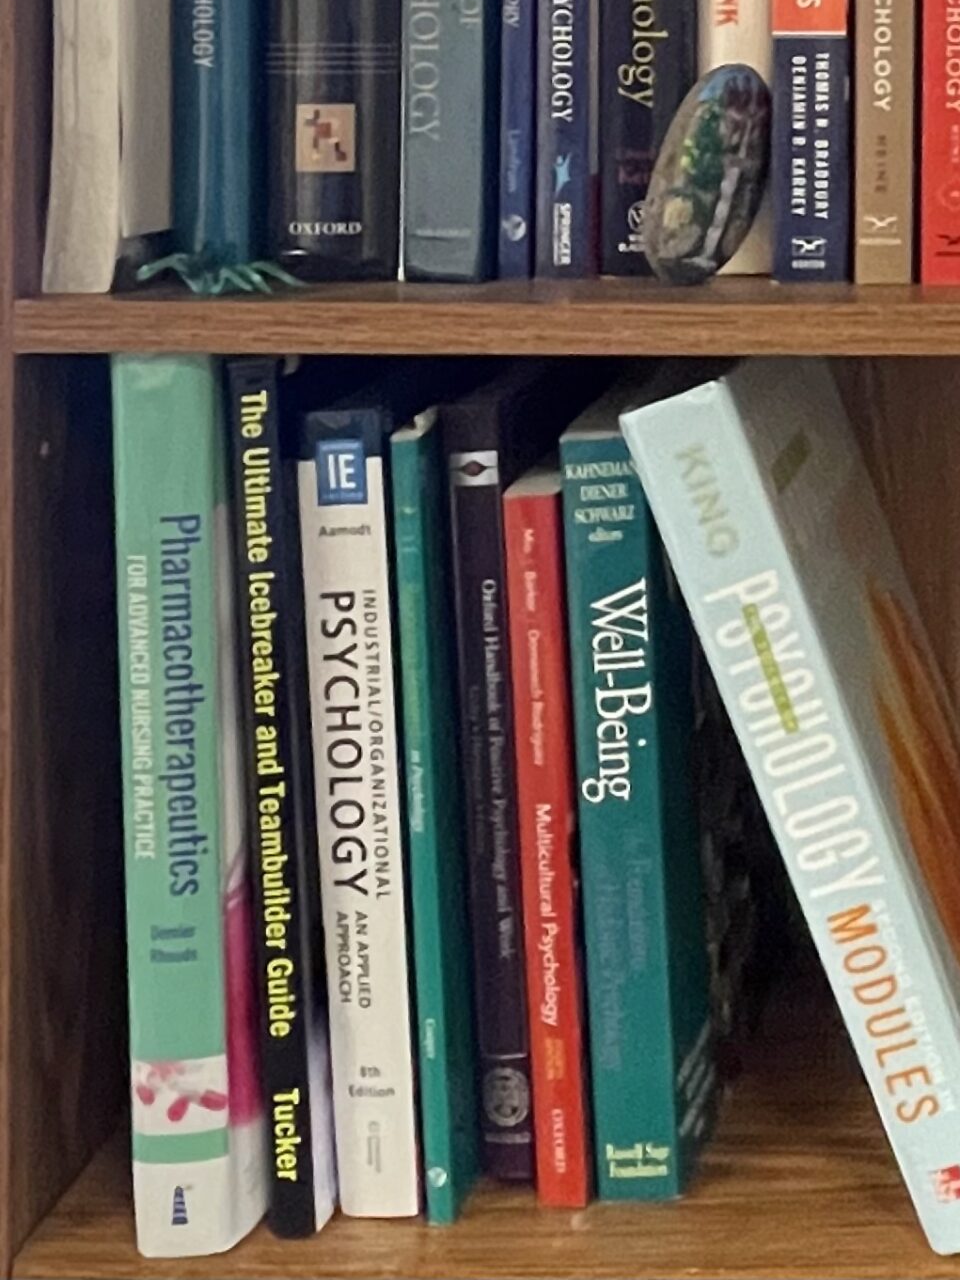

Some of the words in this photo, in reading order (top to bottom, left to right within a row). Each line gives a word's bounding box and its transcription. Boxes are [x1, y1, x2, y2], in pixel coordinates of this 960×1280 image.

[289, 220, 362, 235] OXFORD
[558, 202, 572, 266] SPRINGER
[241, 390, 268, 439] The
[241, 447, 273, 564] Ultimate
[327, 453, 356, 489] IE
[574, 504, 635, 523] SCHWARZ
[579, 483, 629, 500] DIENER
[675, 442, 739, 560] KING
[127, 554, 147, 587] FOR
[318, 524, 371, 538] Aamodt
[128, 592, 152, 684] ADVANCED
[247, 571, 279, 717] Icebreaker
[130, 688, 153, 771] NURSING
[157, 513, 210, 898] Pharmacotherapeutics
[582, 577, 652, 803] Well-Being
[255, 724, 284, 776] and
[319, 589, 369, 898] PSYCHOLOGY
[363, 588, 392, 900] INDUSTRIAL/ORGANIZATIONAL
[704, 570, 885, 899] PSYCHOLOGY
[133, 773, 155, 861] PRACTICE
[534, 803, 559, 918] Multicultural
[258, 781, 291, 950] Teambuilder
[336, 911, 352, 1004] APPROACH
[355, 910, 368, 936] AN
[266, 957, 297, 1038] Guide
[356, 939, 371, 1009] APPLIED
[538, 923, 563, 1027] Psychology
[826, 903, 941, 1125] MODULES
[272, 1087, 301, 1182] Tucker
[348, 1083, 395, 1098] Edition
[552, 1108, 567, 1173] OXFORD
